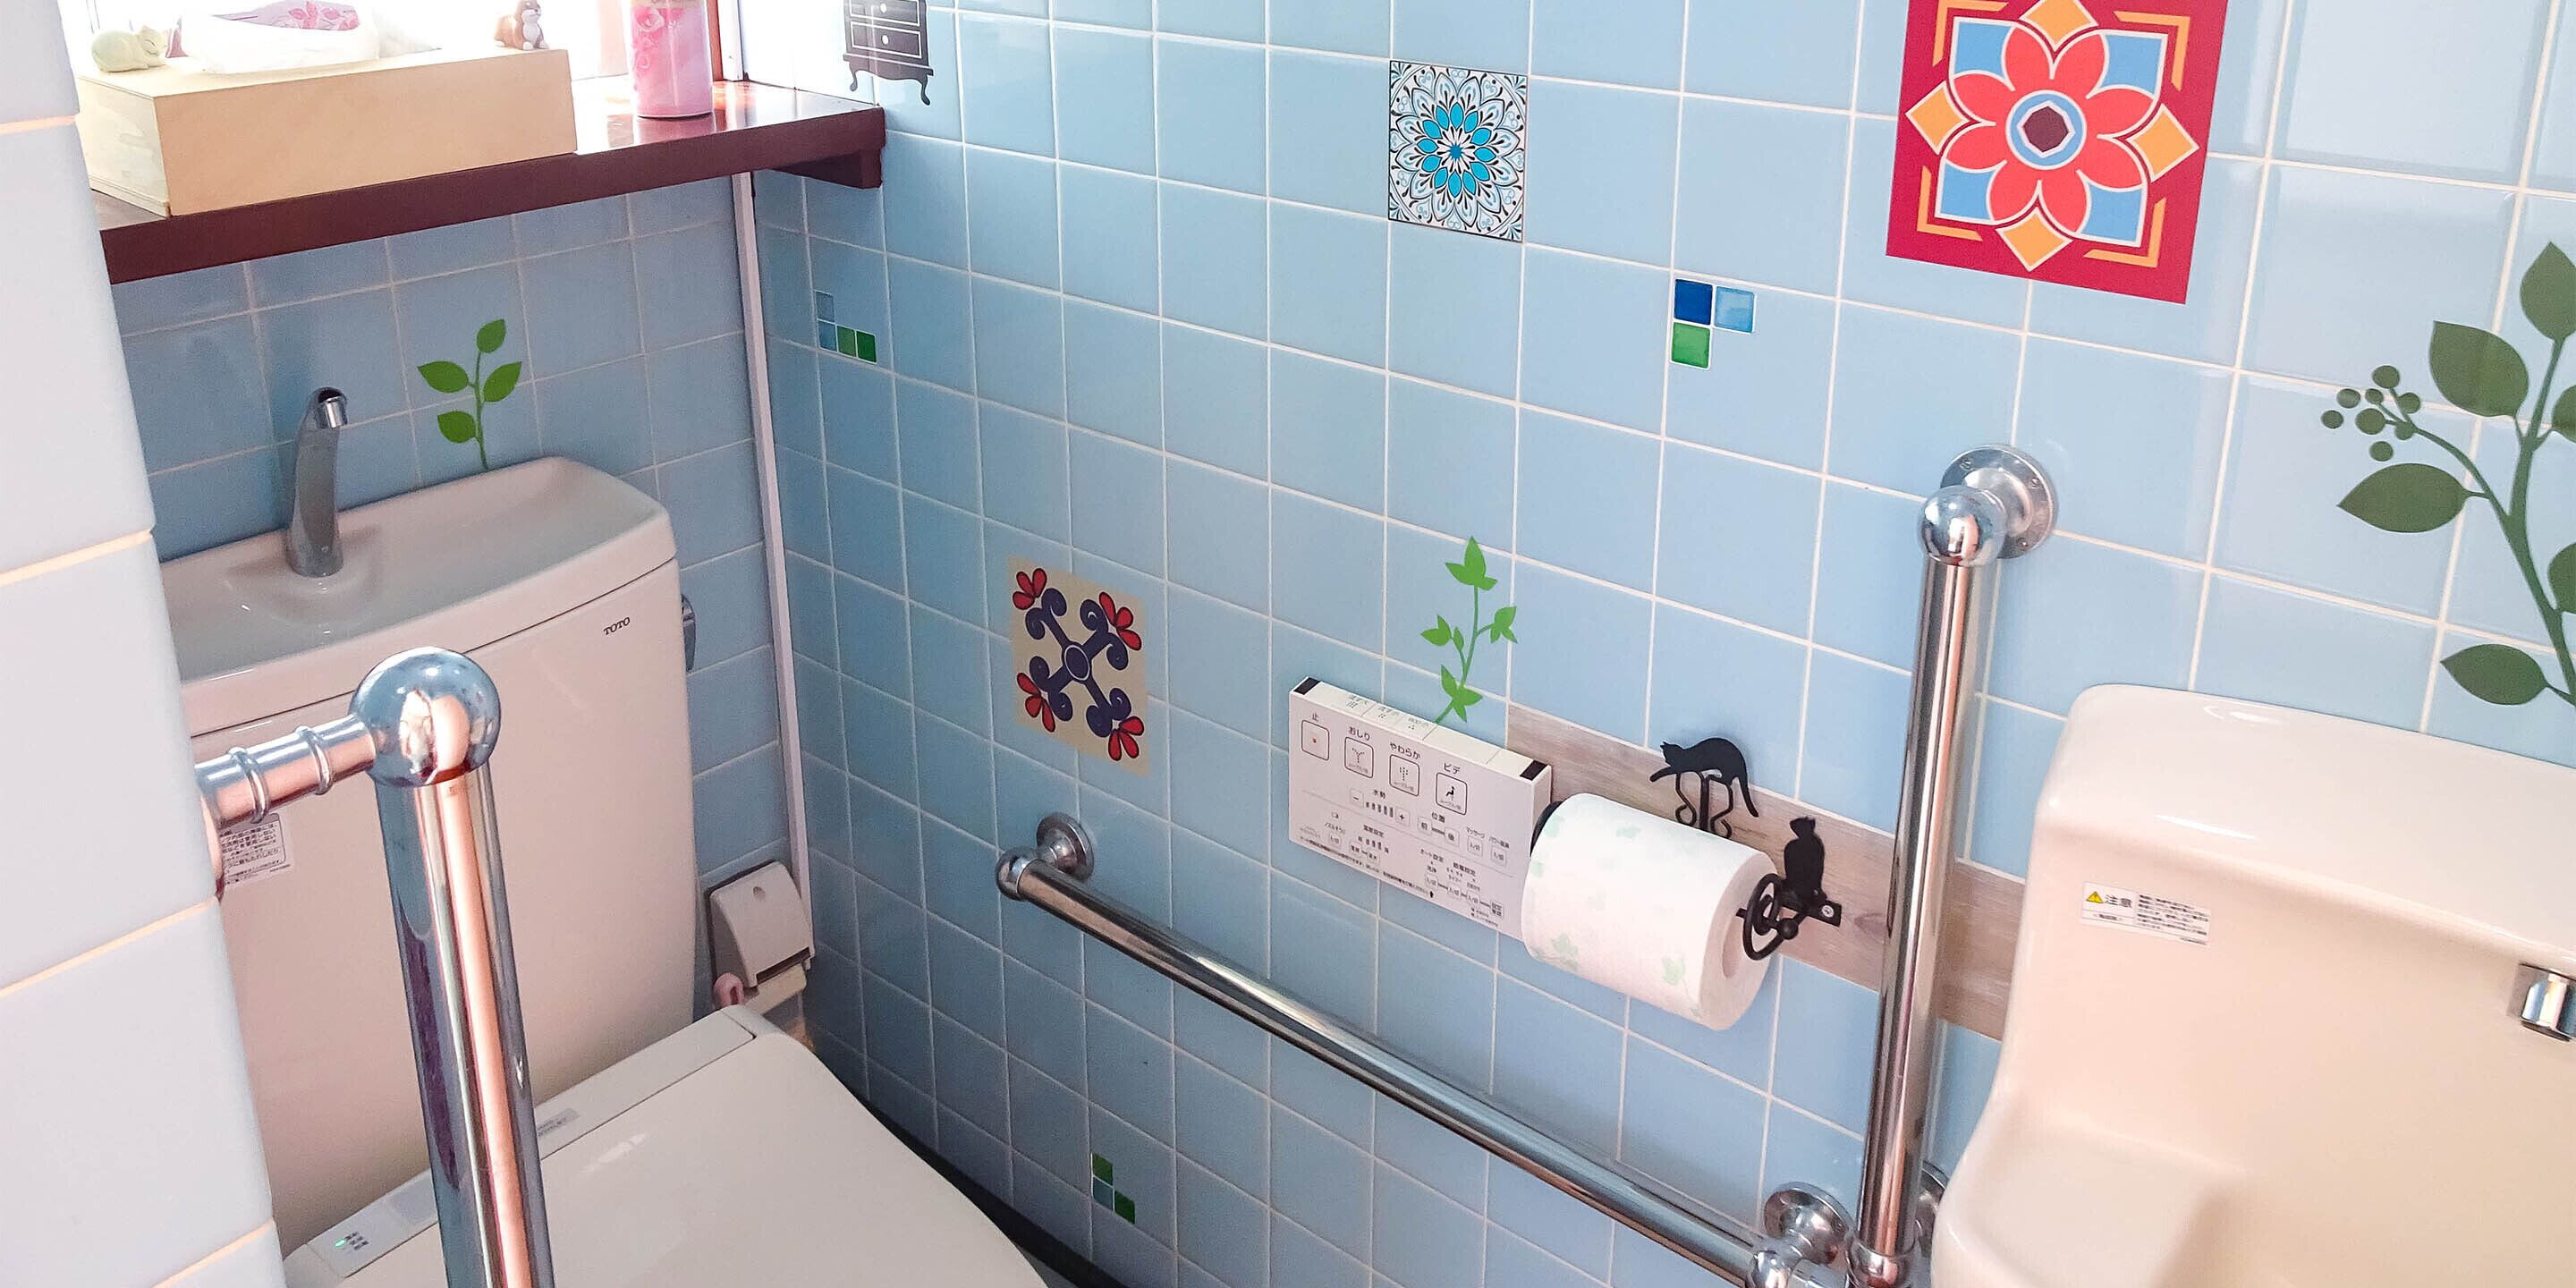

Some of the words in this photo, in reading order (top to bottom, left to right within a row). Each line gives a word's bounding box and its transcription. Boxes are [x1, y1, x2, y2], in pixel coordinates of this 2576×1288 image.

[603, 616, 631, 635] TOTO
[1312, 713, 1319, 722] 止
[1350, 726, 1370, 741] おしり
[1390, 742, 1420, 760] やわらか
[1444, 762, 1461, 775] ビデ
[2104, 894, 2132, 908] 注意
